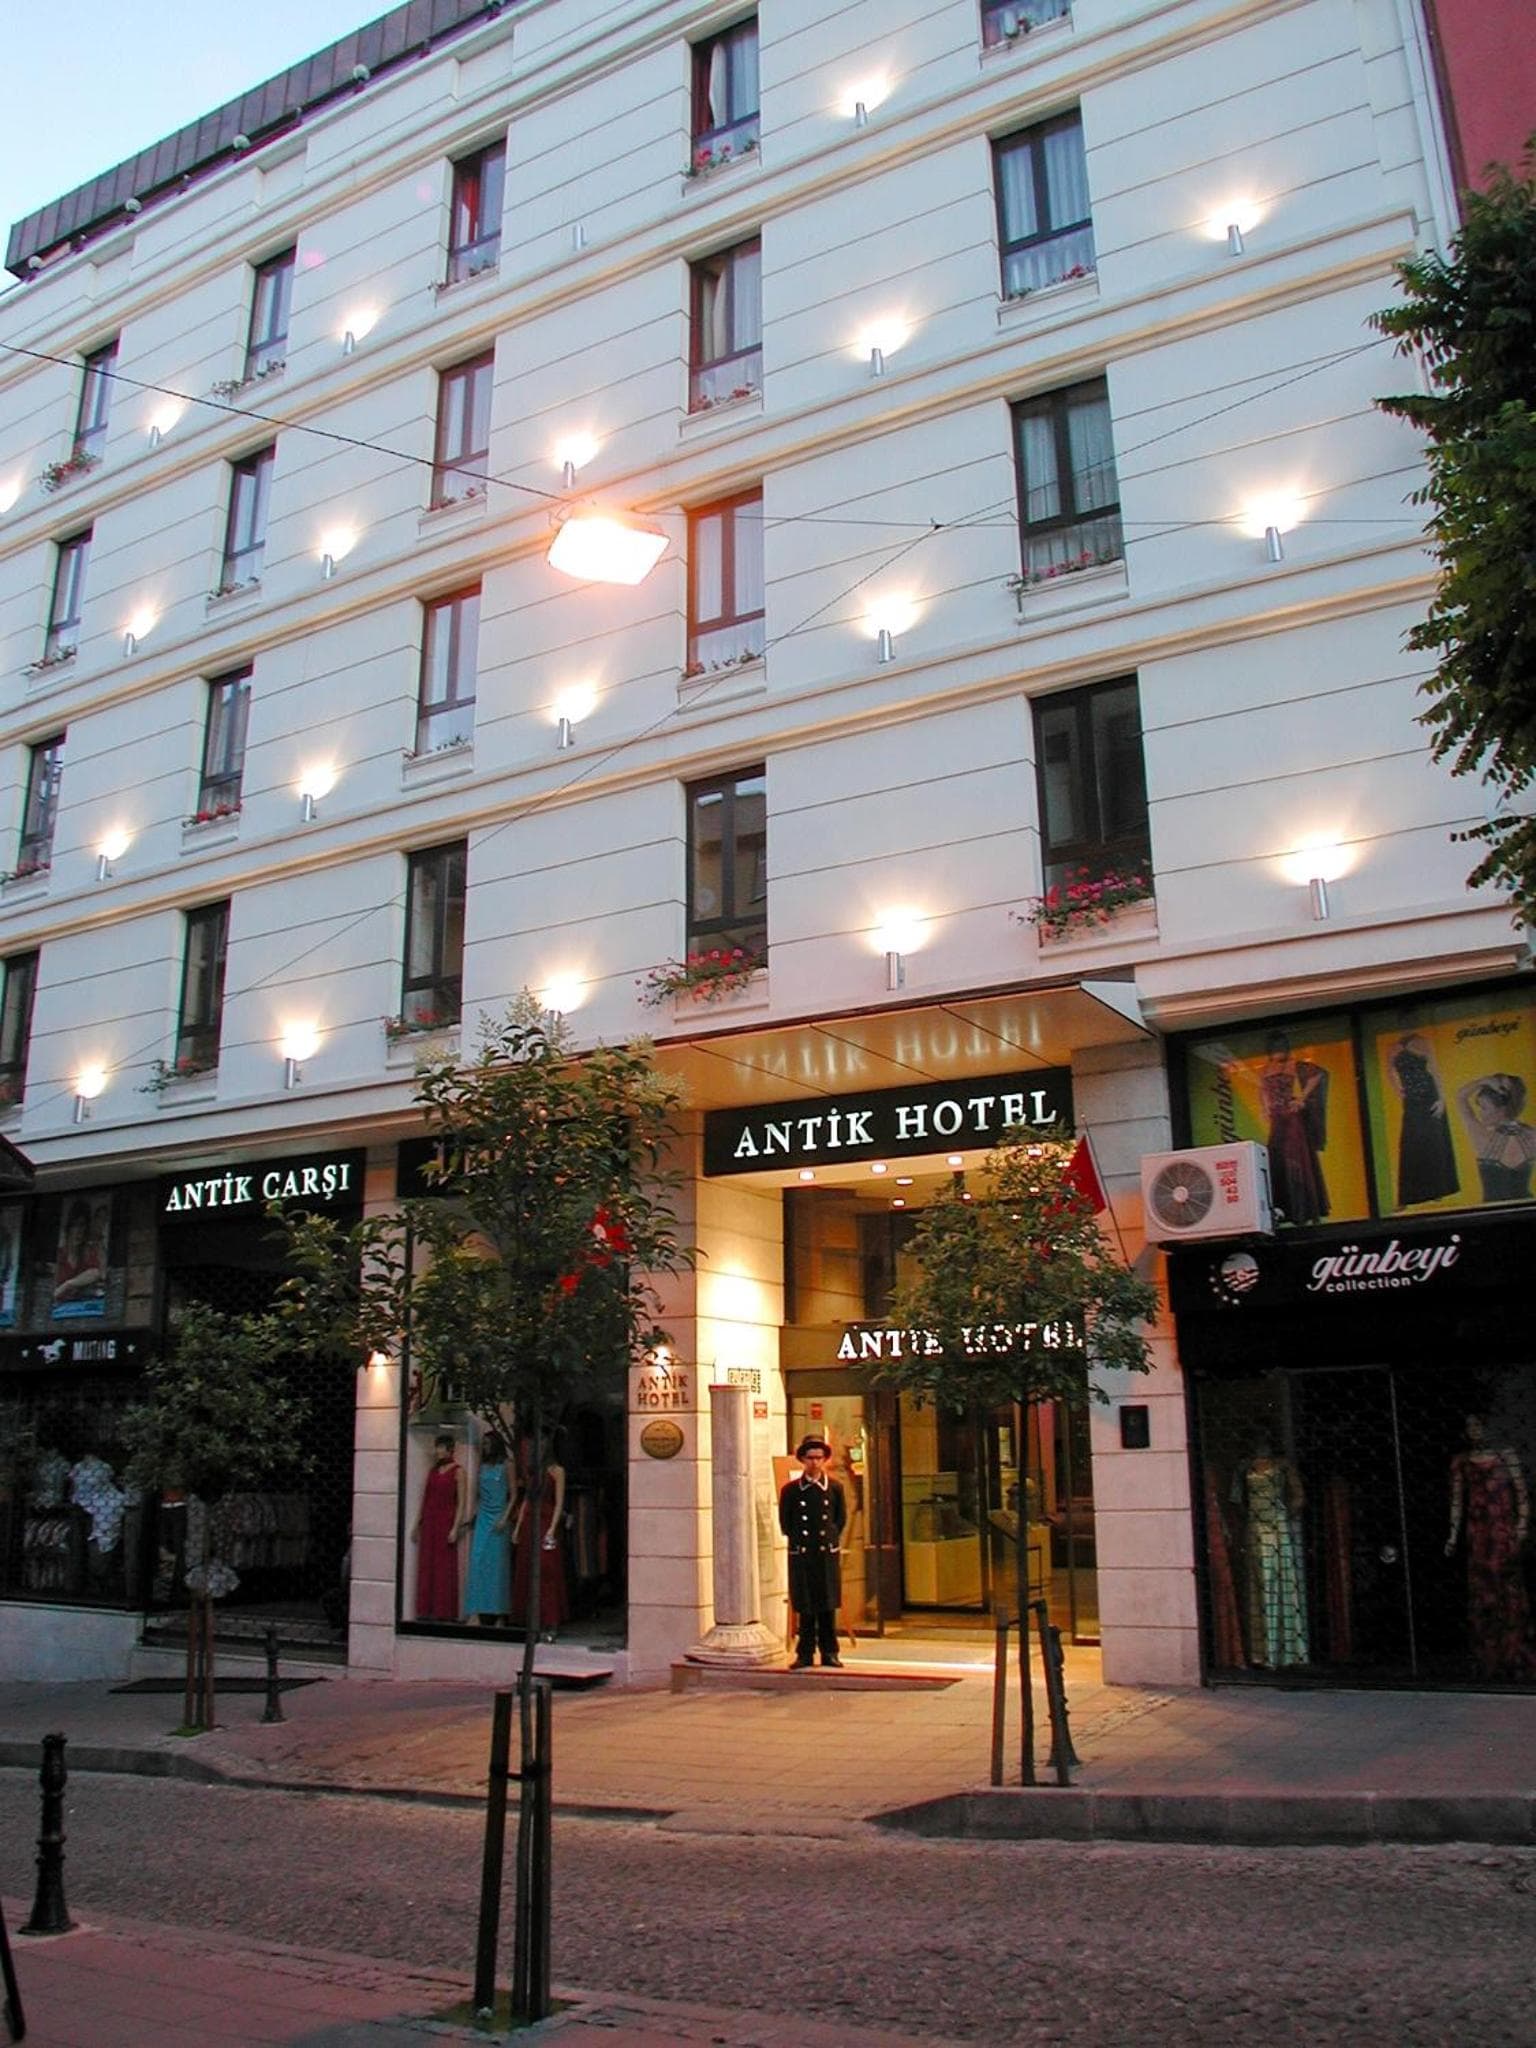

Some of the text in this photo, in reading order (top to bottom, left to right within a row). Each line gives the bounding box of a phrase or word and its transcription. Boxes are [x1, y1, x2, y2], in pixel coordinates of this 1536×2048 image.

[733, 1090, 1057, 1158] ANTİK HOTEL
[165, 1164, 351, 1211] ANTİK CARŞI
[1306, 1234, 1461, 1291] günbeyi
[1326, 1276, 1411, 1293] collection
[637, 1391, 689, 1409] HOTEL
